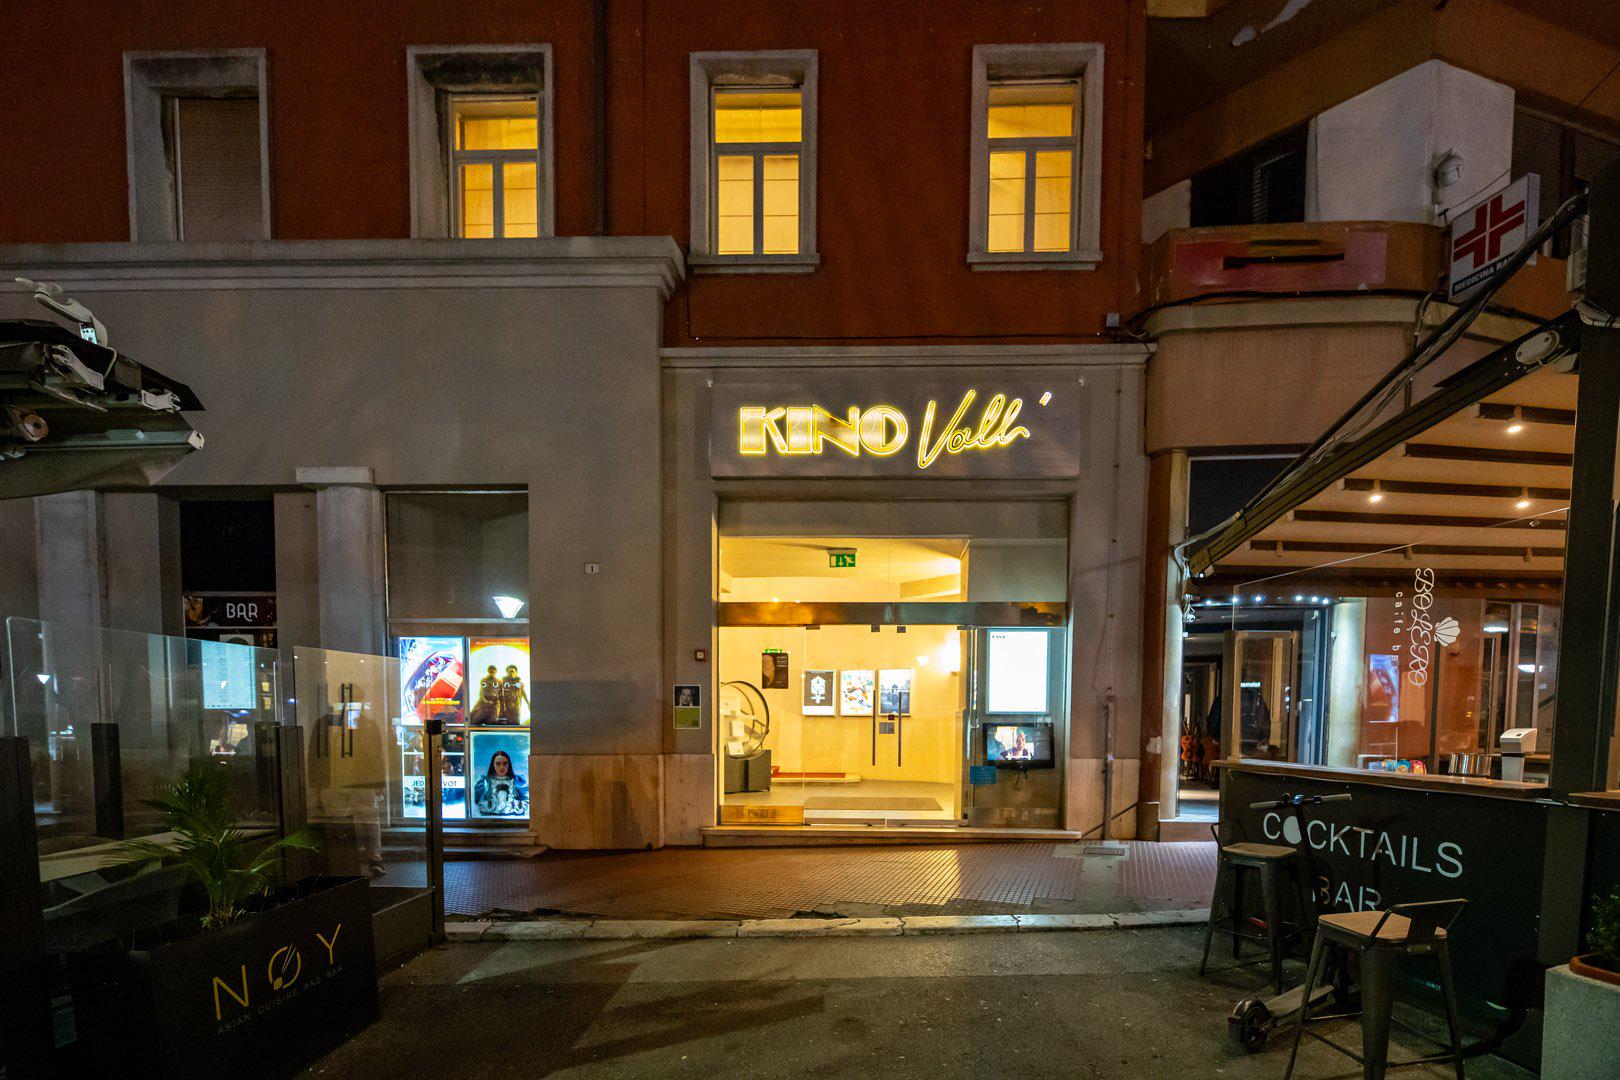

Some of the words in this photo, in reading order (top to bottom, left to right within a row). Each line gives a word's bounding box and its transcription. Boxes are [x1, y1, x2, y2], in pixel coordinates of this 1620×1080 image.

[1455, 266, 1495, 292] MEDICINA
[740, 404, 908, 456] KINO
[917, 389, 1052, 468] Valli
[226, 602, 258, 622] BAR
[1406, 568, 1434, 686] BOLERO
[1263, 812, 1463, 878] COCKTAILS
[1312, 876, 1381, 913] BAR
[213, 923, 341, 1020] NOY
[217, 1013, 251, 1036] ASIAN
[304, 976, 322, 991] AND
